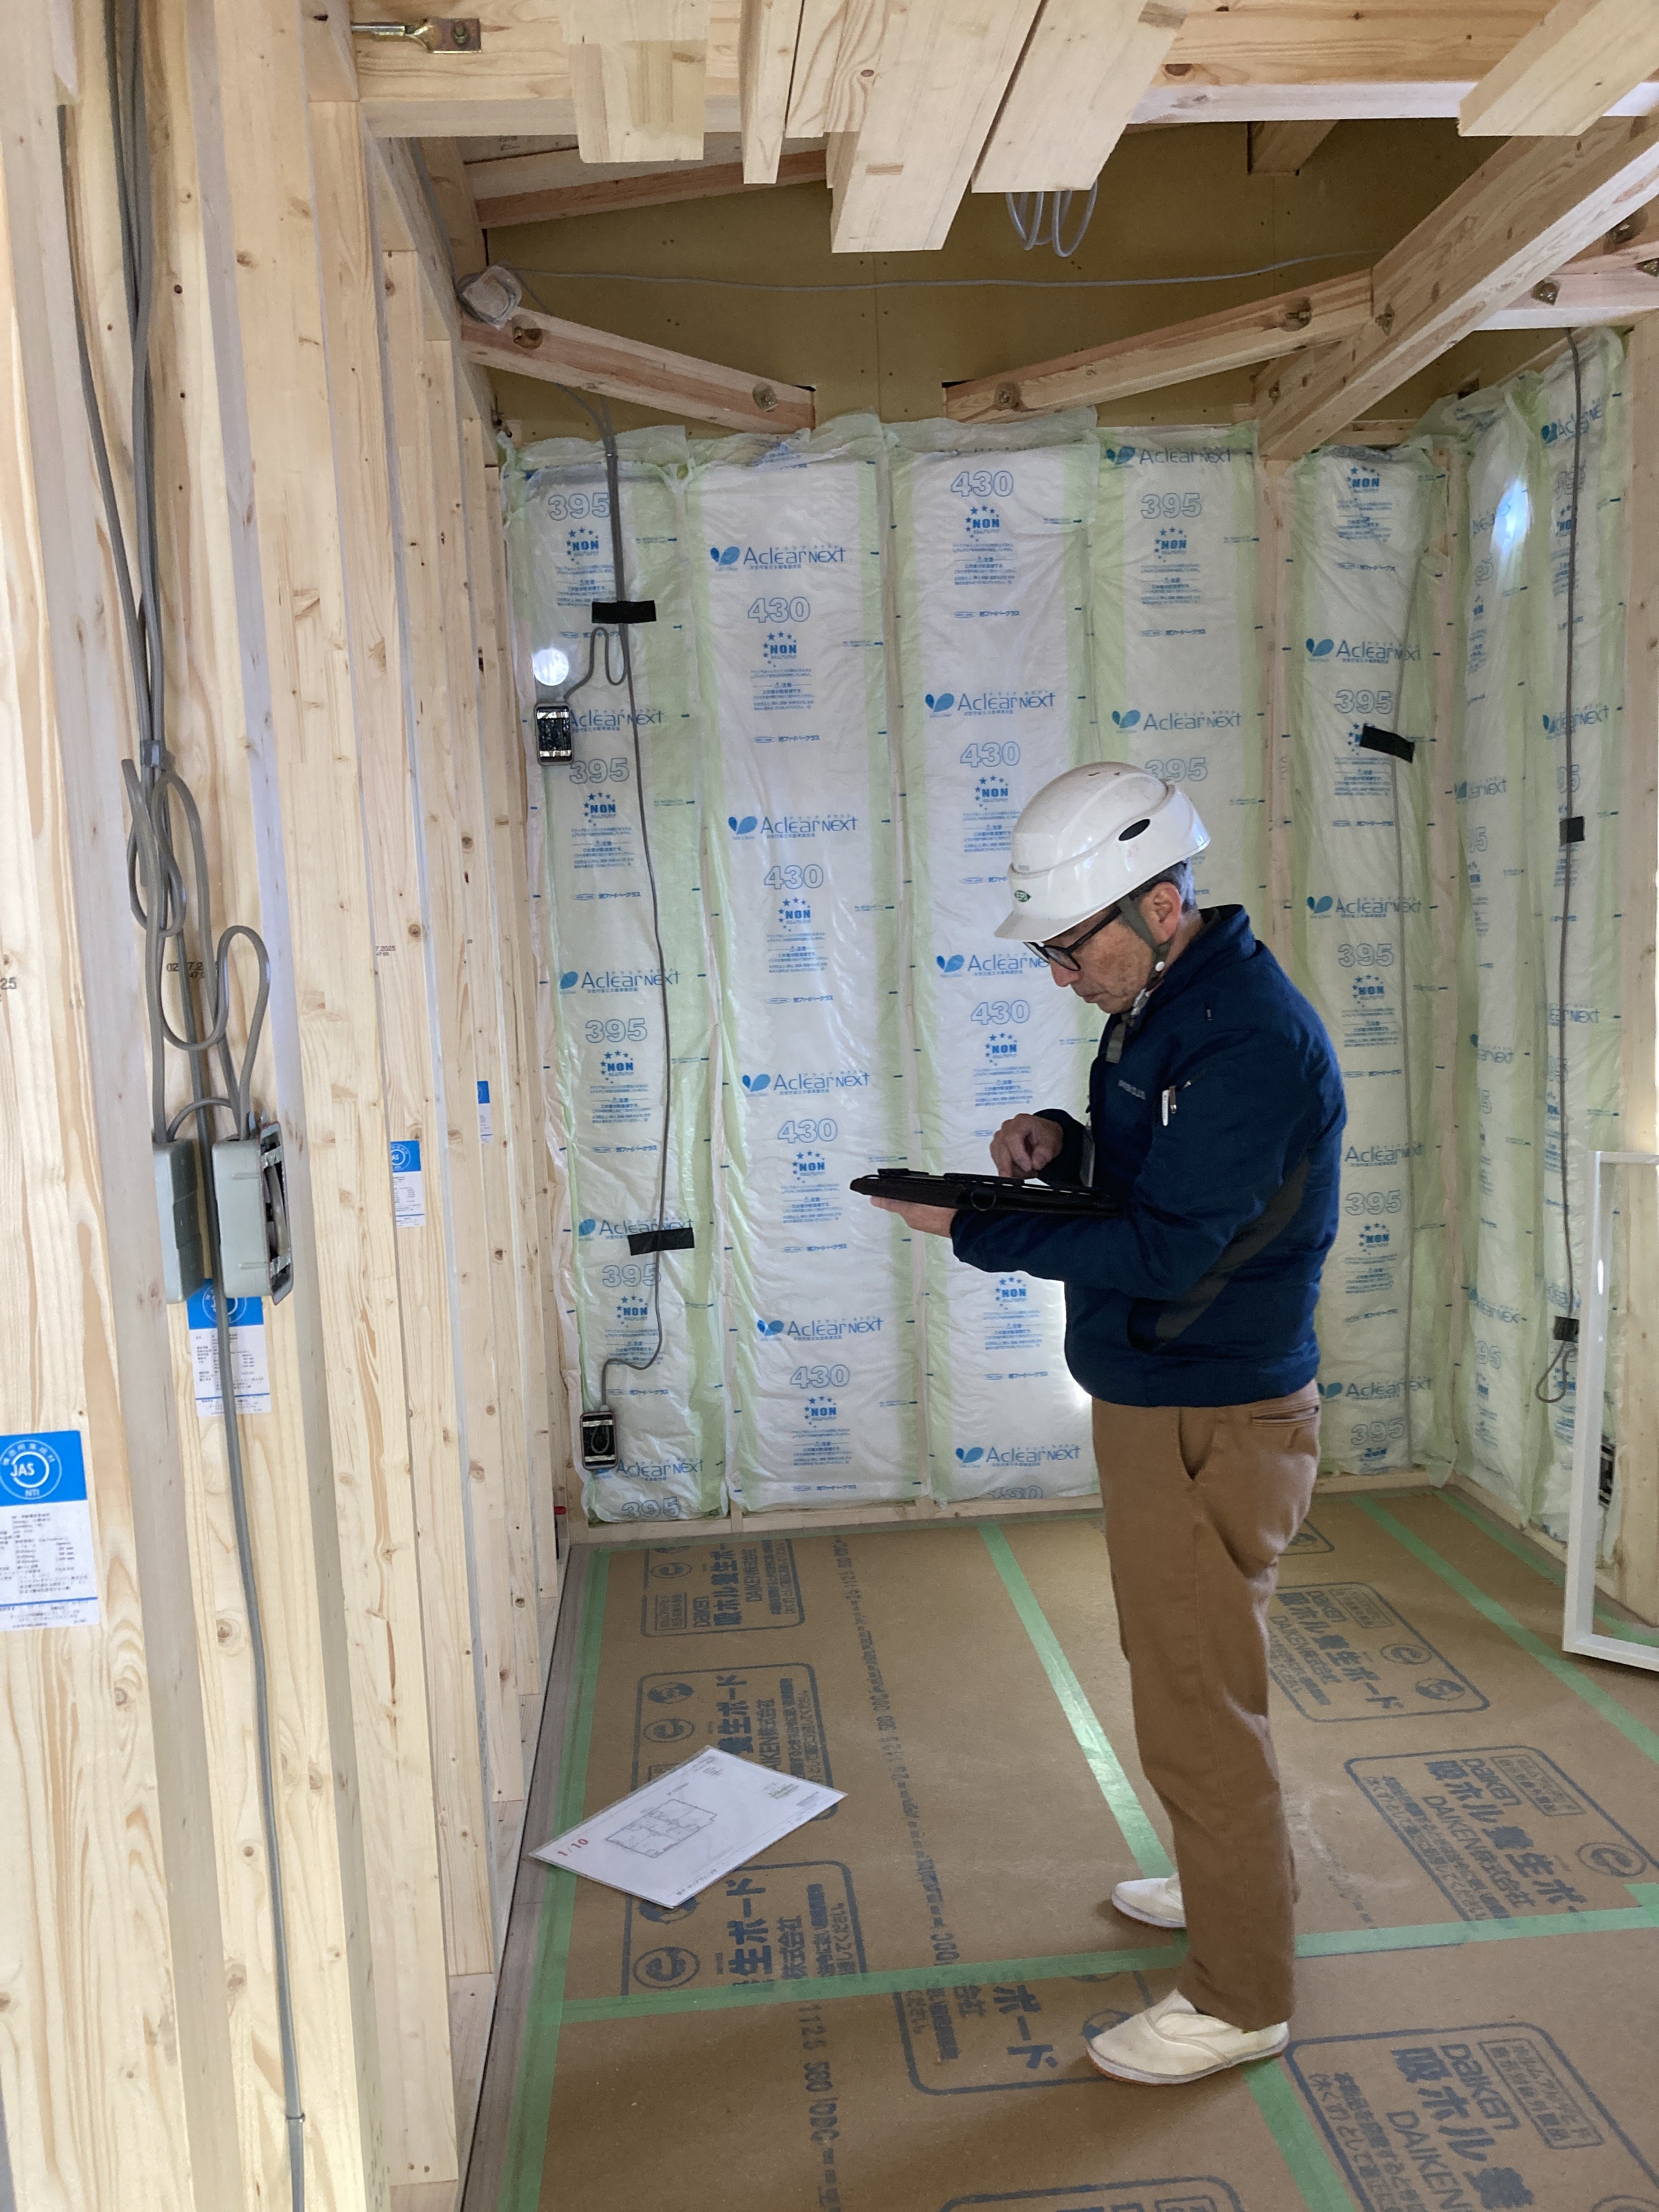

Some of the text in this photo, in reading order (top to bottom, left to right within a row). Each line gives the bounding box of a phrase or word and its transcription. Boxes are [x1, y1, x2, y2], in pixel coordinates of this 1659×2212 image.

[950, 471, 1014, 497] 430
[548, 493, 610, 521] 395
[1141, 493, 1203, 520] 395
[972, 518, 1000, 528] NON
[747, 596, 811, 623] 430
[770, 644, 797, 654] NON
[1334, 690, 1392, 714] 395
[960, 741, 1021, 768] 430
[569, 758, 630, 784] 395
[1144, 757, 1208, 783] 395
[981, 788, 1008, 798] NON
[764, 864, 823, 890] 430
[785, 910, 811, 919] NON
[1338, 943, 1395, 968] 395
[970, 1000, 1030, 1025] 430
[585, 1018, 648, 1043] 395
[992, 1044, 1018, 1054] NON
[777, 1118, 838, 1143] 430
[799, 1161, 825, 1171] NON
[1345, 1189, 1402, 1216] 395
[602, 1263, 662, 1288] 395
[1002, 1288, 1027, 1297] NON
[790, 1364, 850, 1389] 430
[811, 1407, 837, 1417] NON
[1351, 1417, 1405, 1446] 395
[10, 1463, 36, 1477] JAS
[622, 1496, 681, 1519] 395
